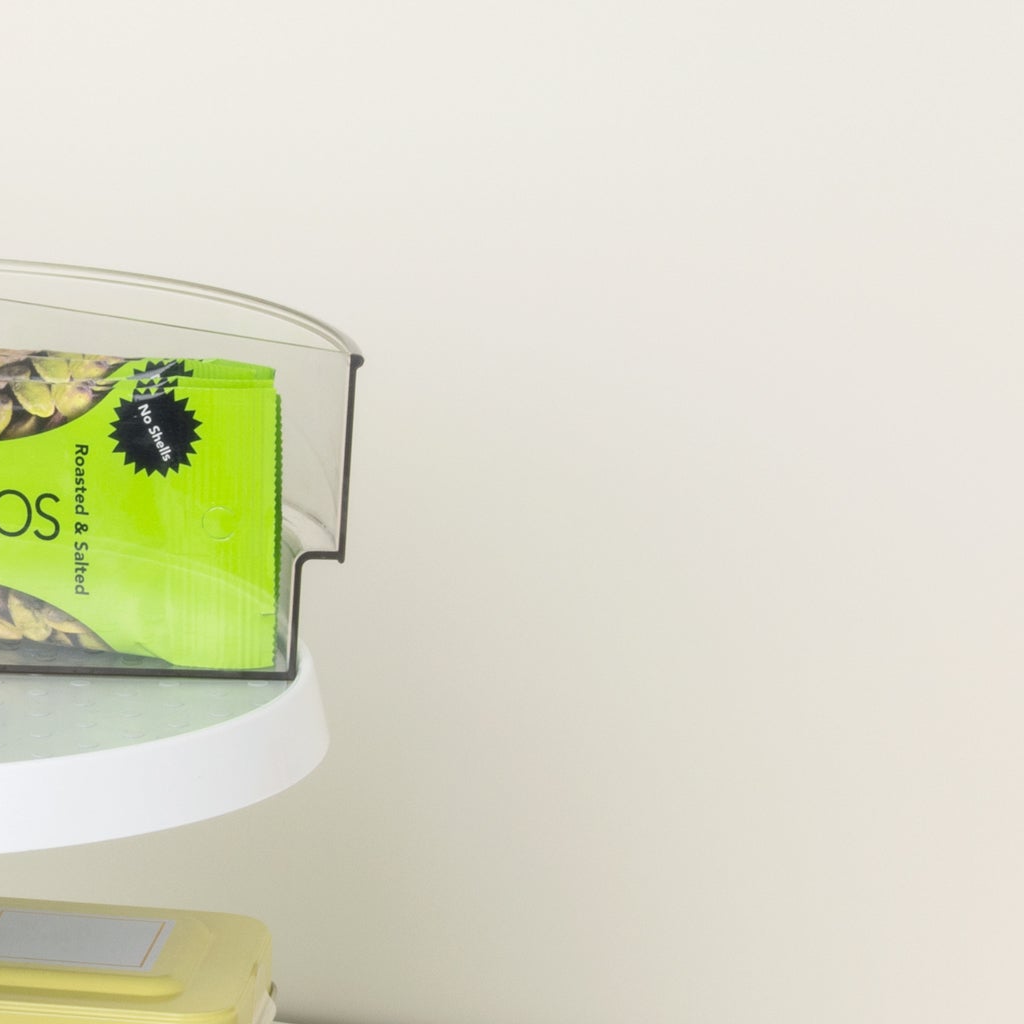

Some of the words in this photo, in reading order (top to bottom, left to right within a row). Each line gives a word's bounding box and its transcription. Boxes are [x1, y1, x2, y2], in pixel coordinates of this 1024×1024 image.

[137, 403, 152, 425] No
[148, 425, 172, 462] Shells
[75, 444, 89, 516] Roasted
[74, 521, 89, 535] &
[74, 541, 89, 596] Salted
